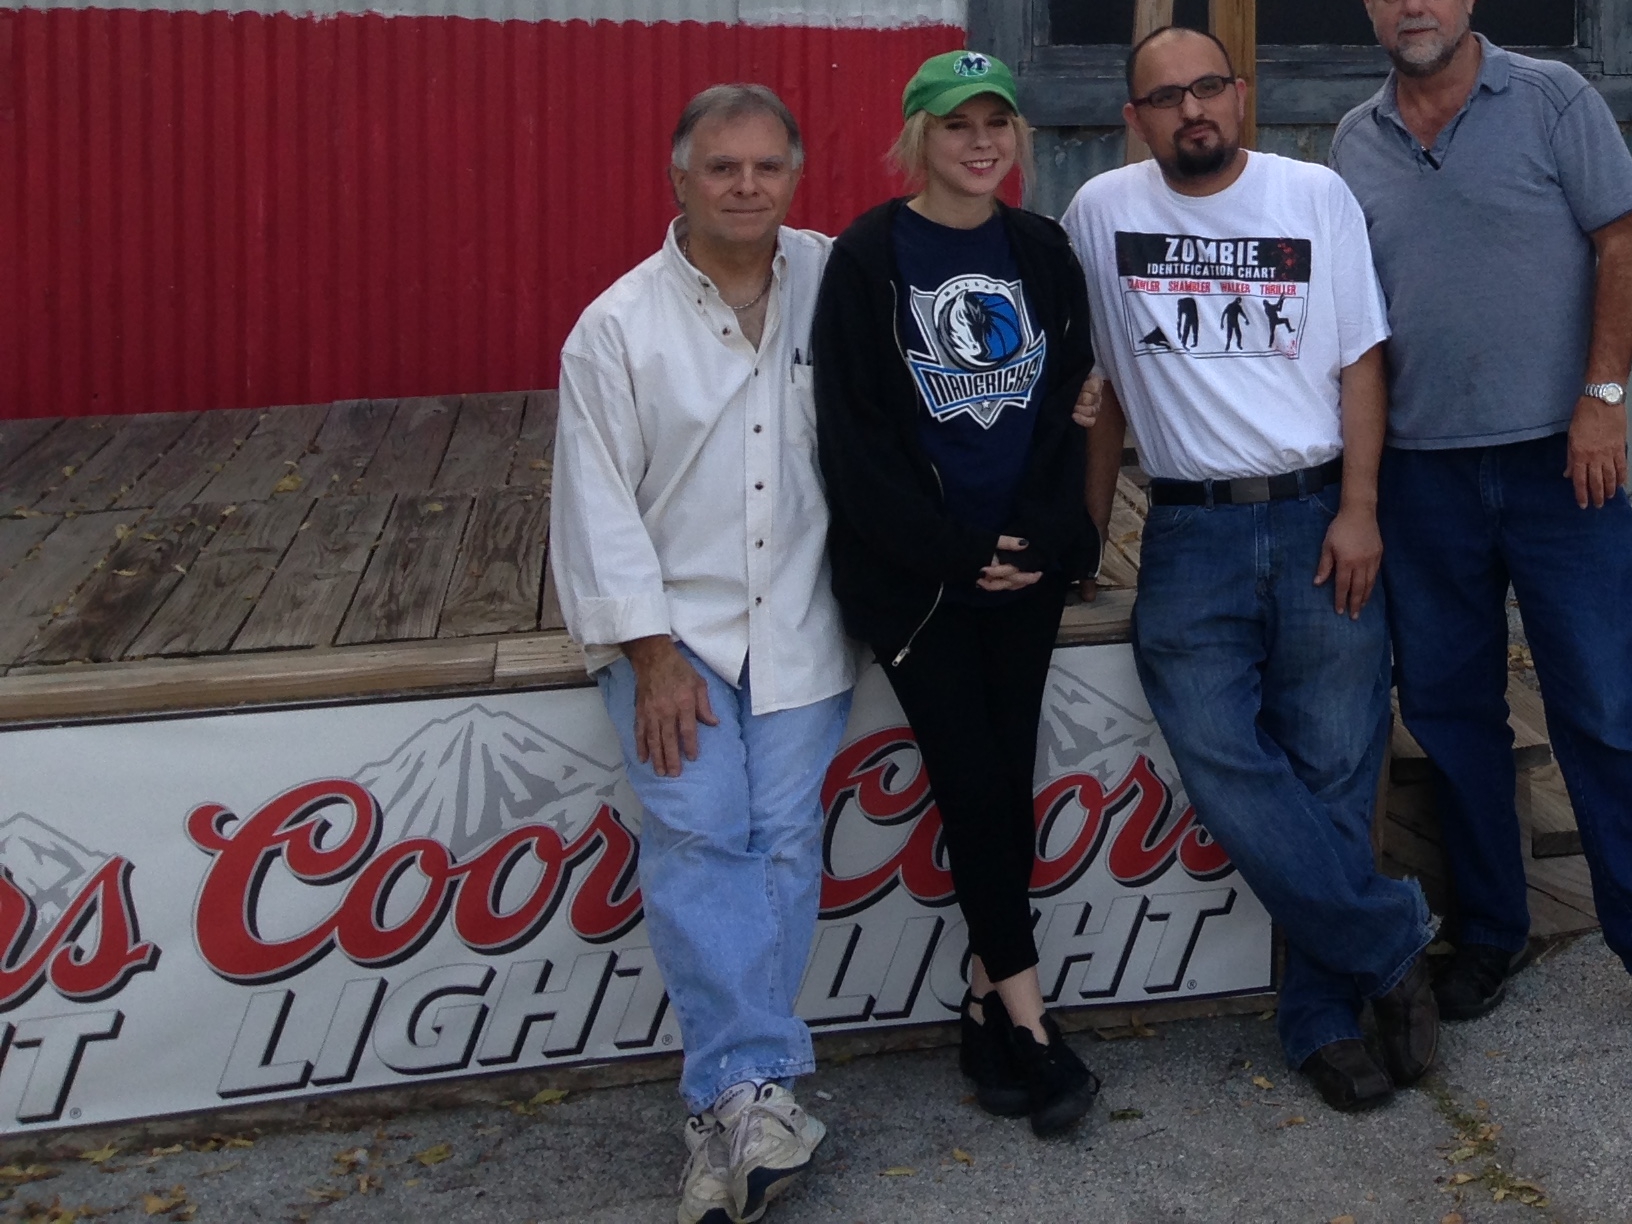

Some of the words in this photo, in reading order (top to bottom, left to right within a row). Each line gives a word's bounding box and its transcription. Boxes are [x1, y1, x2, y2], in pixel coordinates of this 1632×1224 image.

[1147, 262, 1234, 277] IDENTIFICATION
[1237, 266, 1277, 279] CHART
[1164, 237, 1260, 266] ZOMBIE
[1168, 280, 1211, 294] SHAMBLER
[1220, 281, 1251, 295] WALKER
[1260, 282, 1297, 296] THRILLER
[919, 353, 1042, 407] MAVERICKS
[184, 777, 647, 986] Coor
[216, 946, 672, 1099] LIGHT
